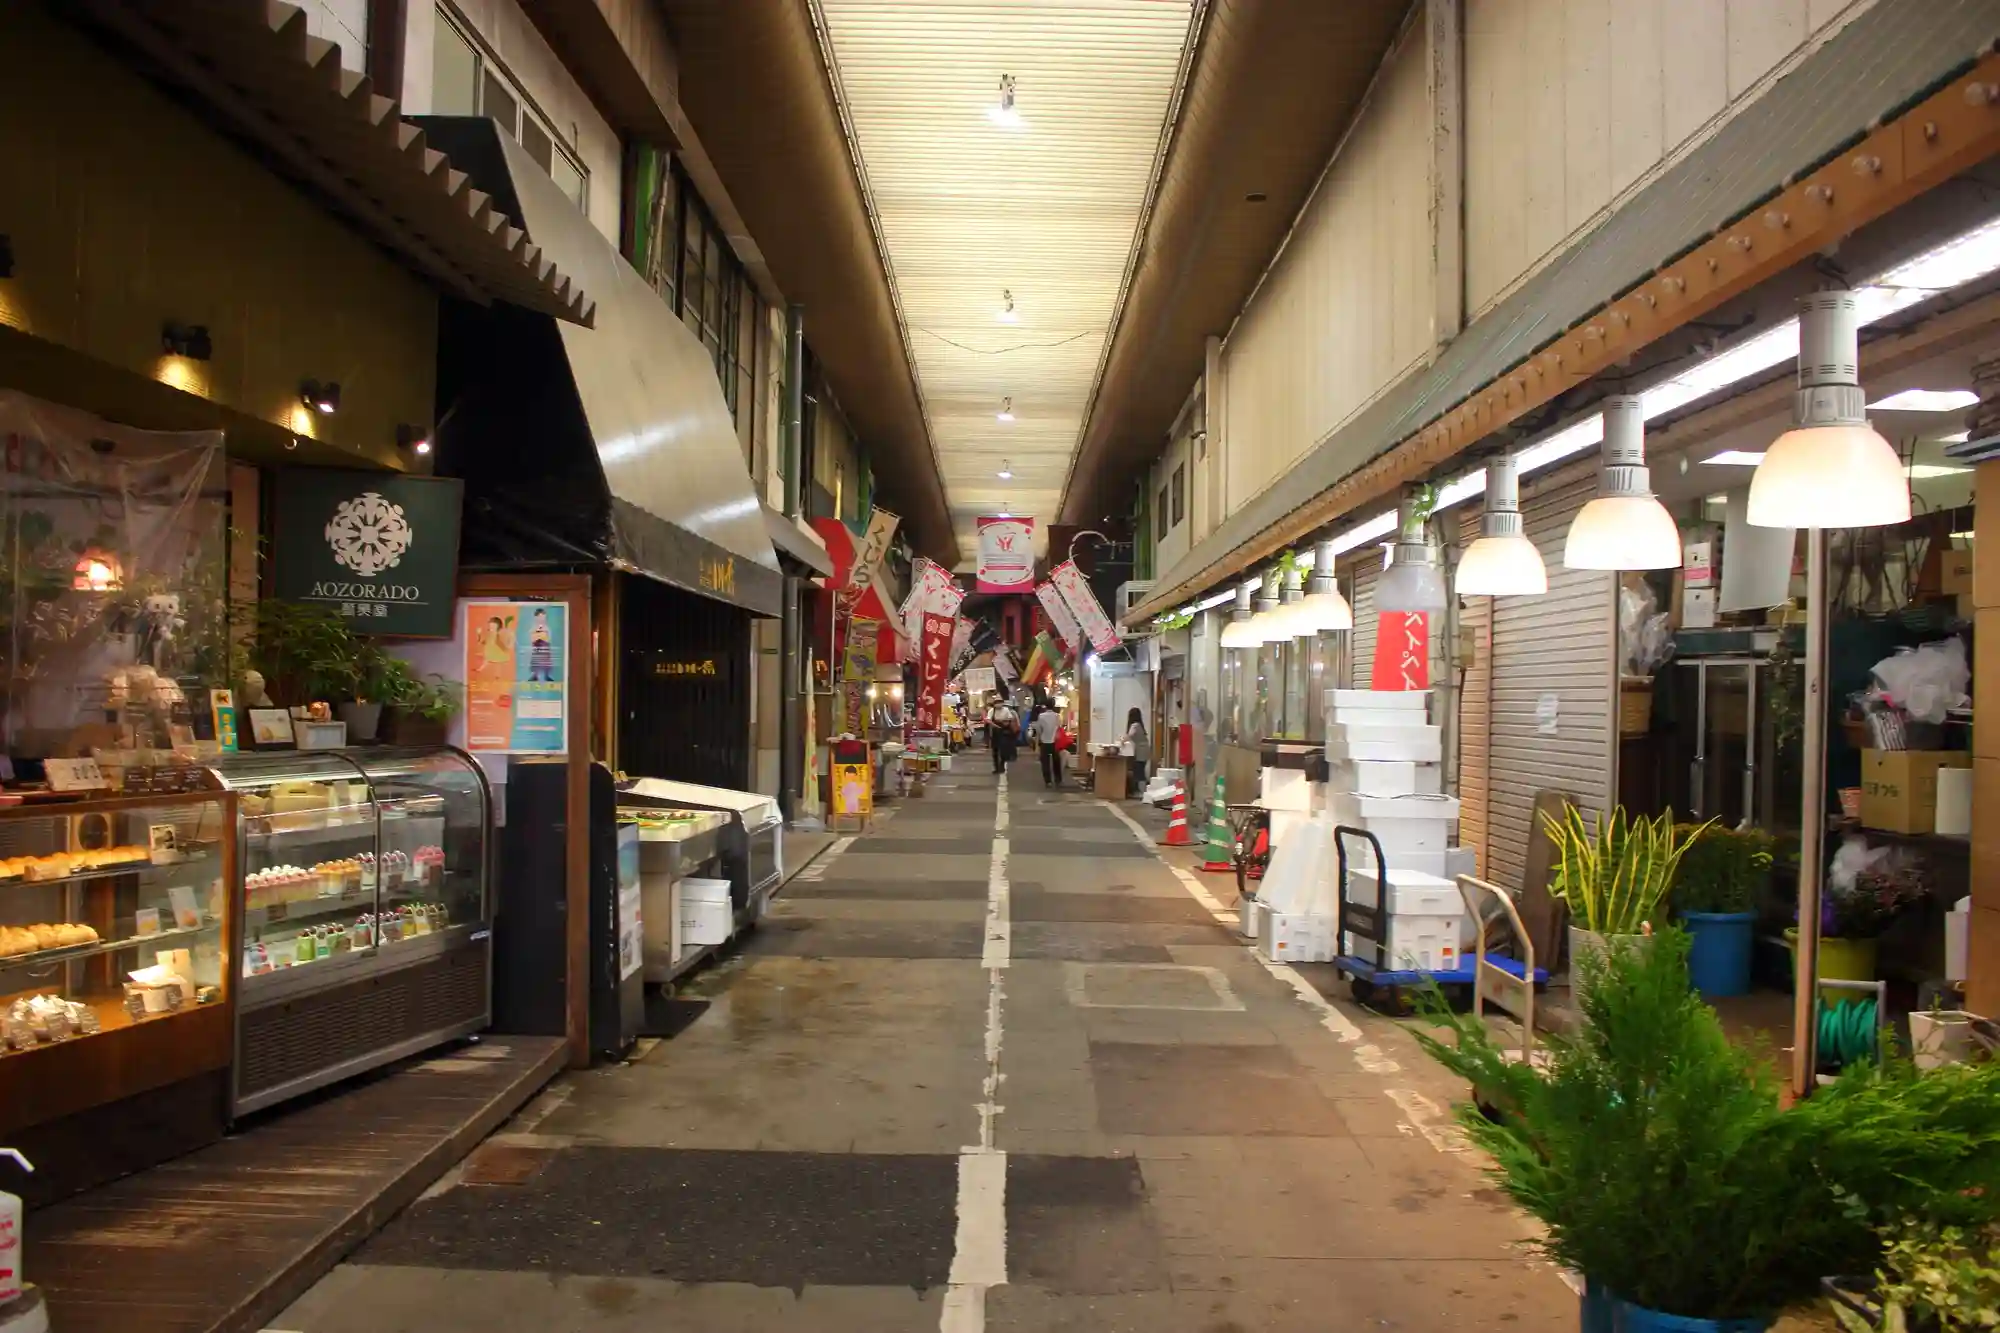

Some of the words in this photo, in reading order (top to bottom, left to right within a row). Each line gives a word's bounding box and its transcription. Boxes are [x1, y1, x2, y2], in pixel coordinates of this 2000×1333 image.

[852, 523, 886, 584] くじら
[311, 581, 420, 601] AOZORADO
[921, 637, 942, 706] くじら
